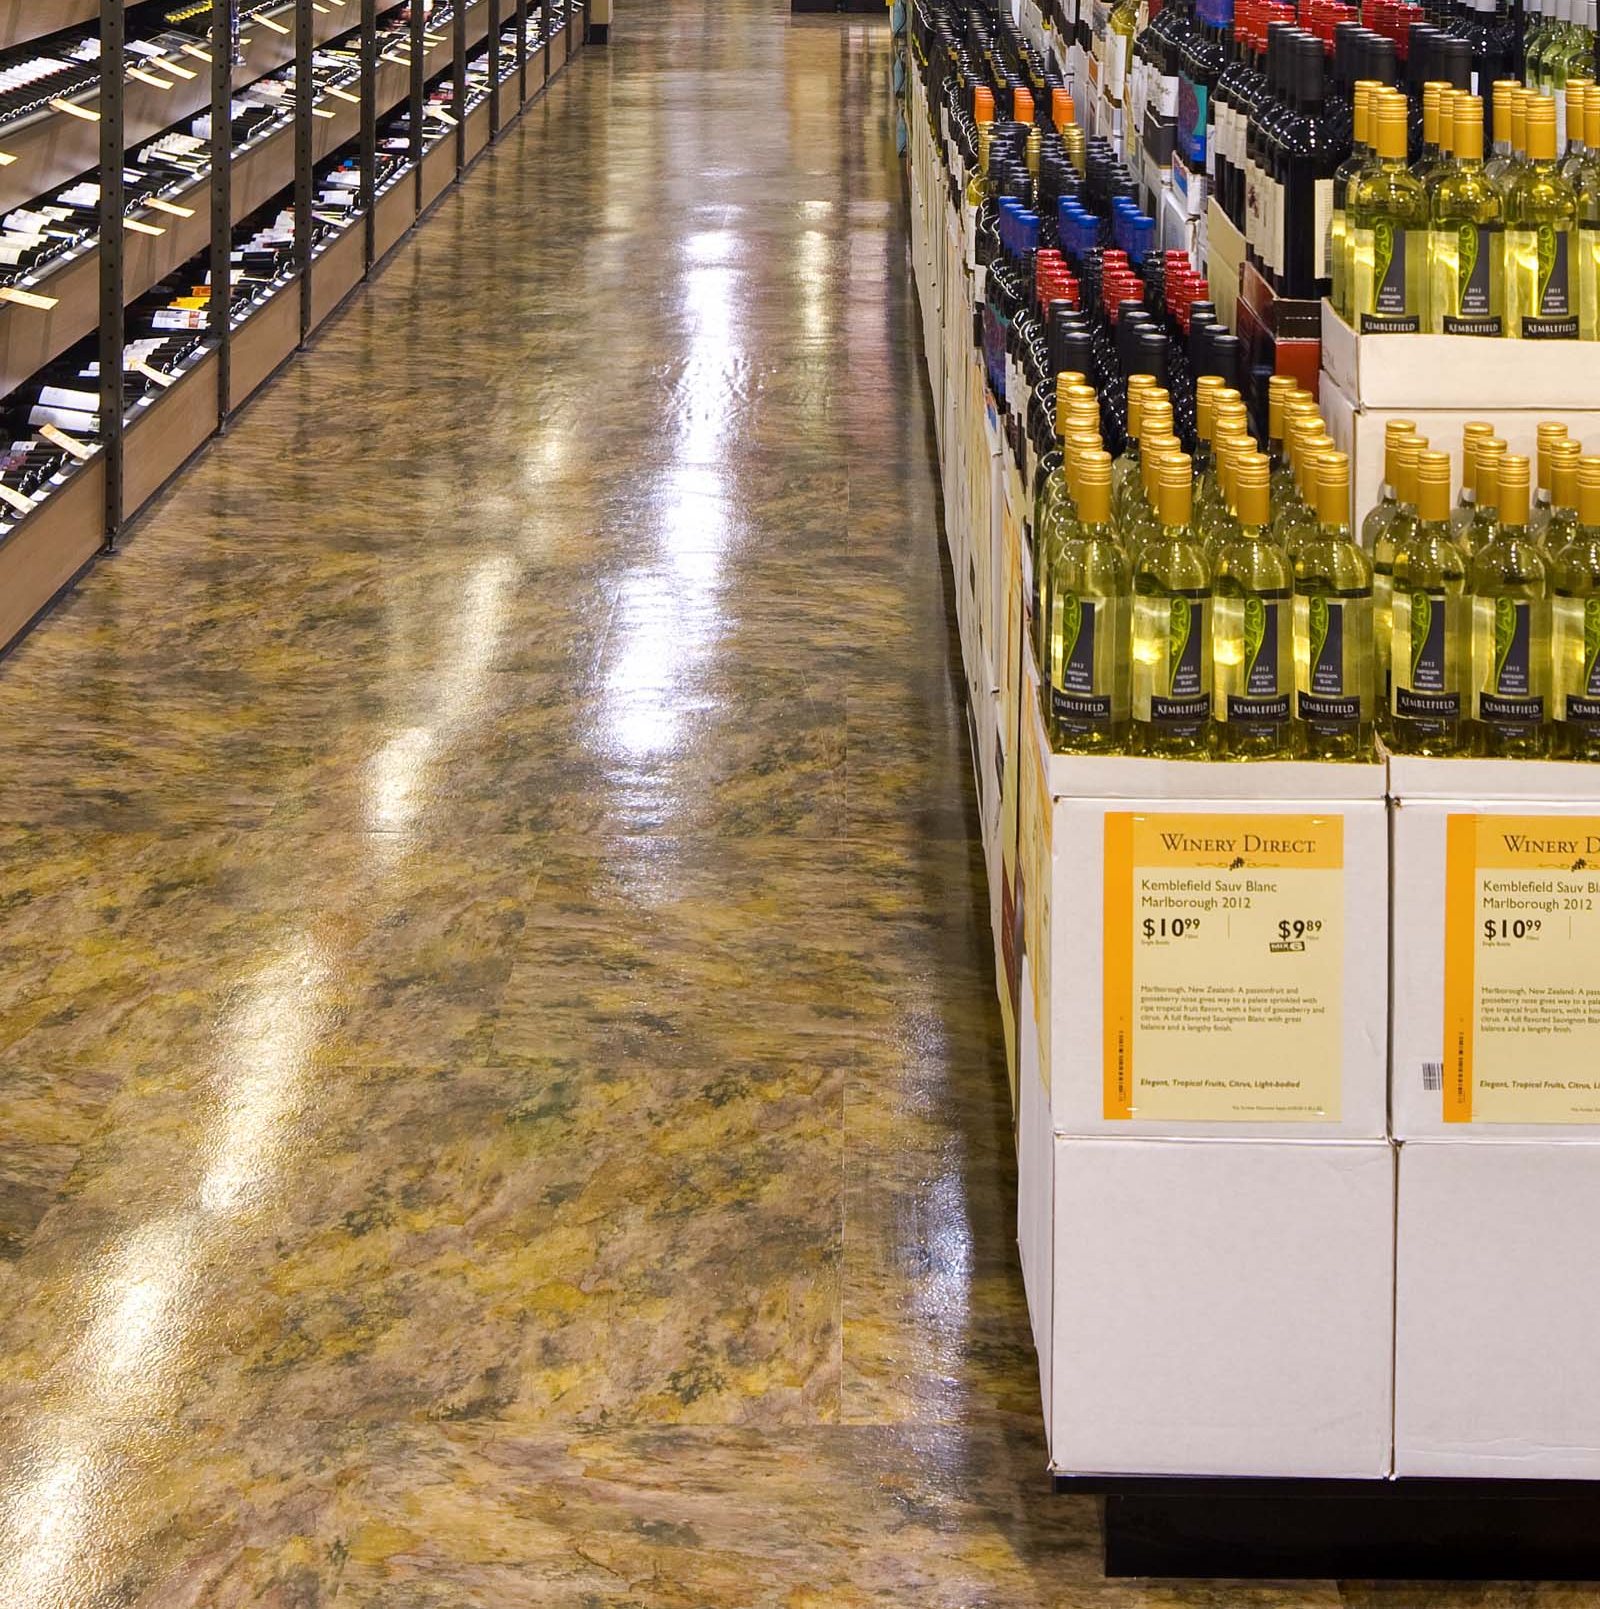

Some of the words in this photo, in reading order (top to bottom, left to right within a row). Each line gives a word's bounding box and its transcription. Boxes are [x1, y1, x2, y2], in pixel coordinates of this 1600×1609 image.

[1160, 833, 1236, 852] WINERY
[1243, 834, 1316, 853] DIRECT
[1141, 880, 1211, 892] Kemblefield
[1215, 880, 1242, 892] Sauv
[1246, 880, 1277, 893] Blanc
[1141, 897, 1218, 911] Marlborough
[1222, 897, 1251, 908] 2012
